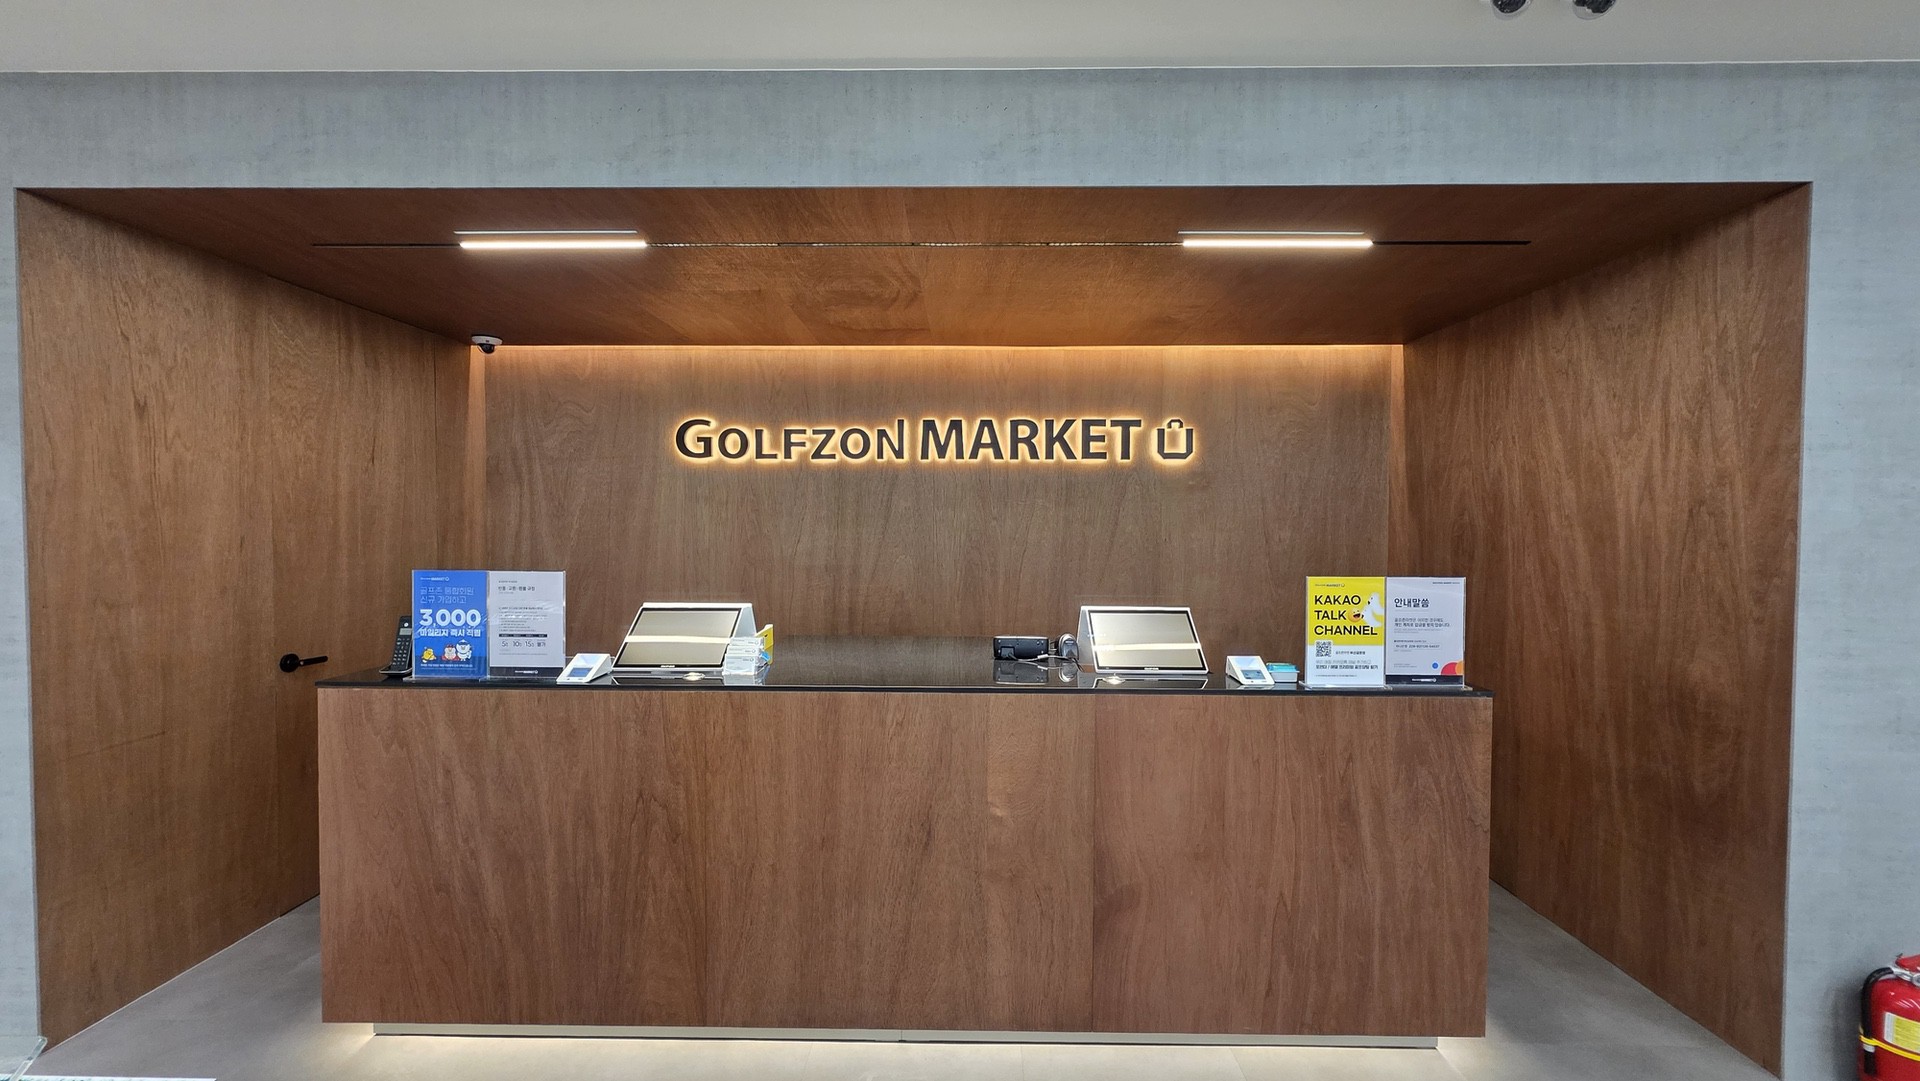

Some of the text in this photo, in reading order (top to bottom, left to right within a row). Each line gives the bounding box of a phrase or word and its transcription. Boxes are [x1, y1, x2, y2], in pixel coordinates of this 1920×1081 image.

[675, 418, 1142, 461] GOLFZON MARKET
[420, 595, 467, 604] 신규 가입하고
[1314, 595, 1361, 605] KAKAO
[1394, 597, 1430, 608] 안내말씀
[419, 608, 482, 628] 3,000
[1314, 610, 1347, 620] TALK
[419, 628, 481, 637] 마일리지 즉시 적립
[1314, 625, 1378, 635] CHANNEL
